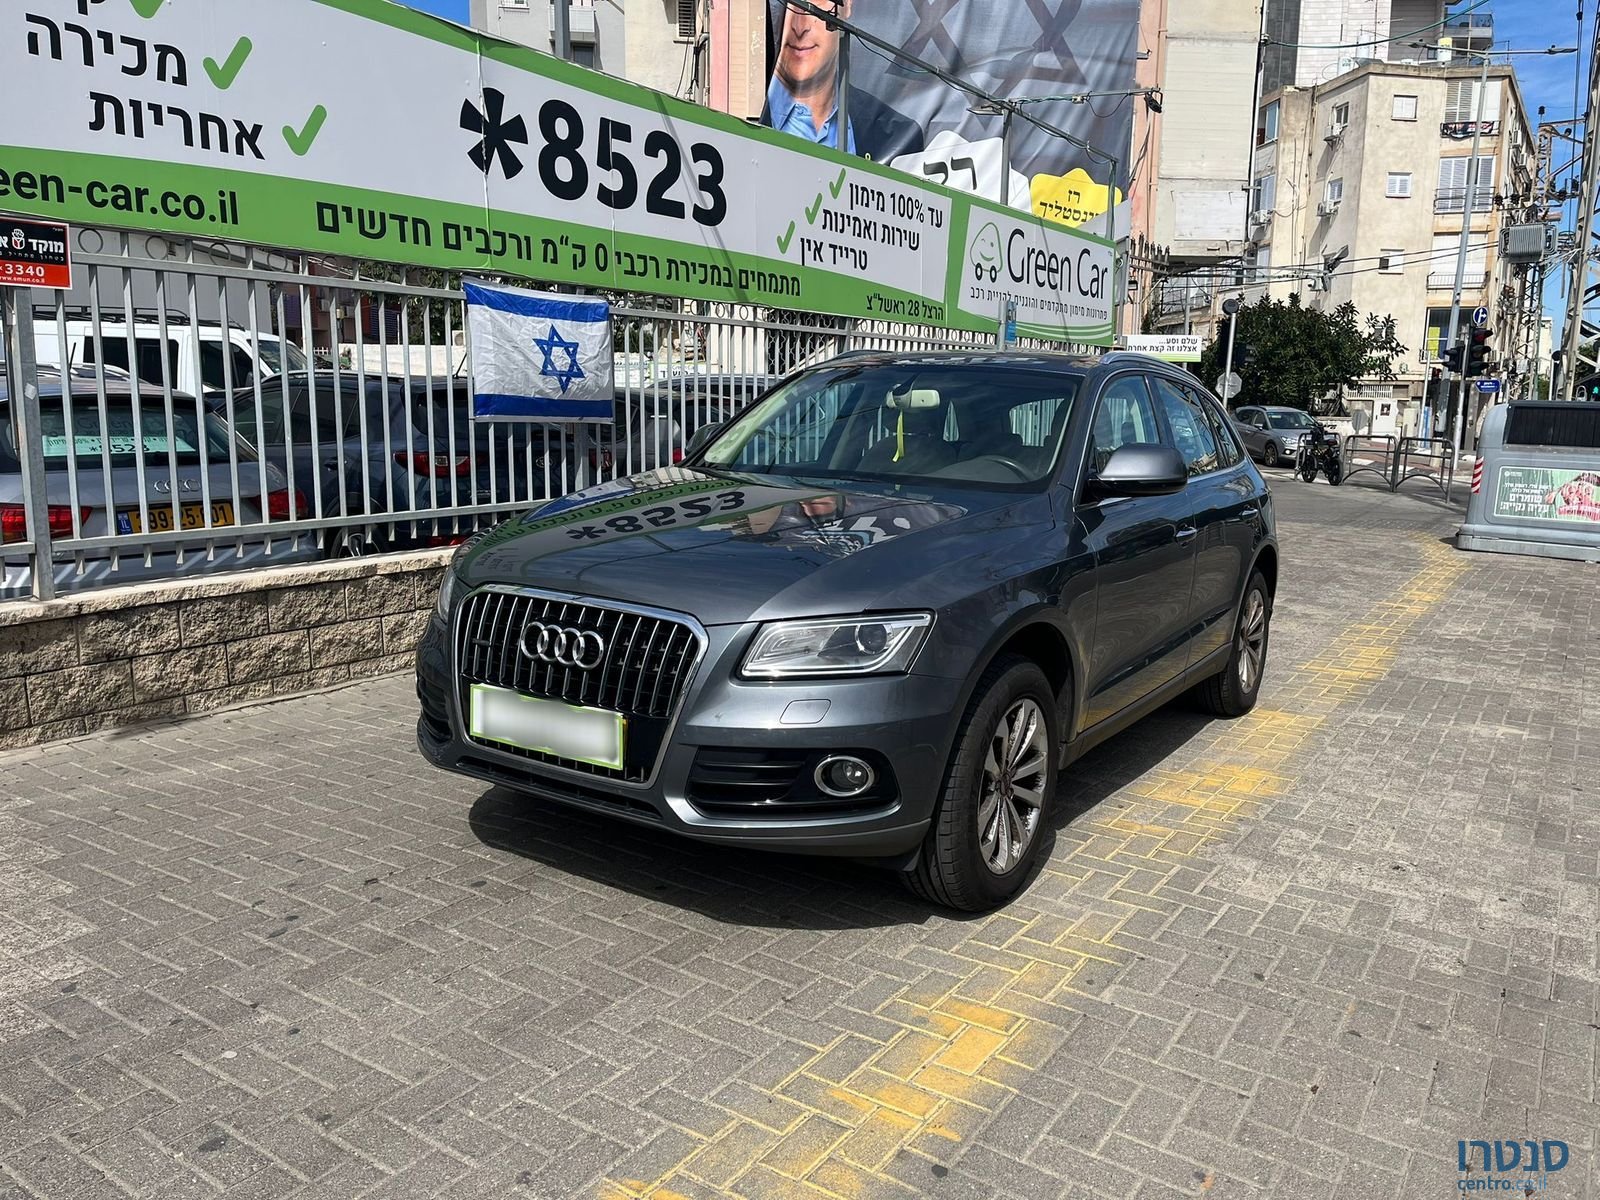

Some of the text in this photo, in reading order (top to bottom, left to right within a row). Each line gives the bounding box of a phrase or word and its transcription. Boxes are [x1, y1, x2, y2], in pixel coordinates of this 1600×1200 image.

[25, 12, 188, 87] מכירה
[88, 90, 266, 160] אחריות
[849, 182, 943, 229] עד 100% מימון
[1068, 189, 1081, 204] רז
[316, 201, 432, 247] חדשים
[1039, 200, 1100, 223] ינסטליך
[442, 222, 532, 261] ורכבים
[822, 208, 920, 251] שירות ואמינות
[28, 238, 64, 254] מוקד
[595, 242, 609, 272] 0
[800, 237, 868, 271] טרייד אין
[614, 250, 660, 279] רכבי
[666, 257, 733, 288] במכירת
[1007, 228, 1108, 300] Green Car
[738, 268, 801, 297] מתמחים
[970, 286, 985, 300] רכב
[907, 299, 920, 317] 28
[922, 301, 944, 321] הרצל
[1149, 345, 1165, 353] קצת
[1181, 337, 1198, 345] שלם
